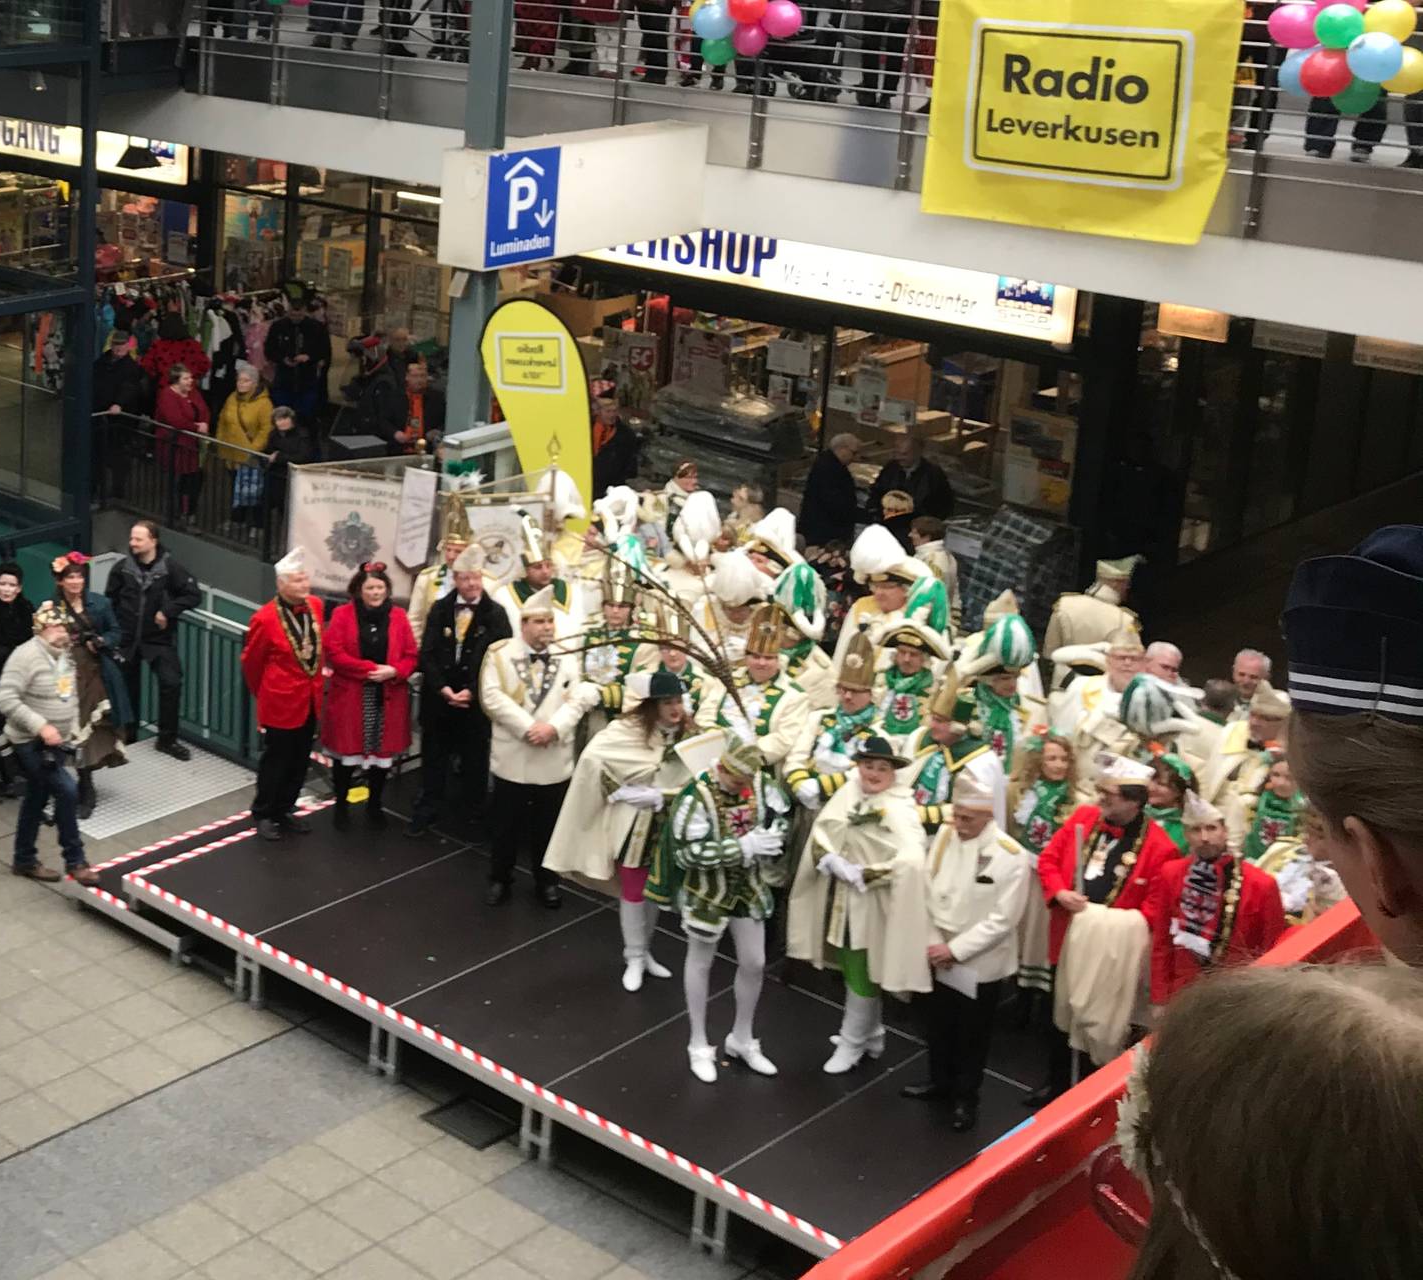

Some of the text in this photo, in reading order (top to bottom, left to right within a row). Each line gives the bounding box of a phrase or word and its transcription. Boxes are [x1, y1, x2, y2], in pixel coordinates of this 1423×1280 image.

[1003, 53, 1150, 104] Radio
[986, 108, 1160, 148] Leverkusen
[508, 176, 538, 230] P
[489, 234, 551, 257] Luminaden
